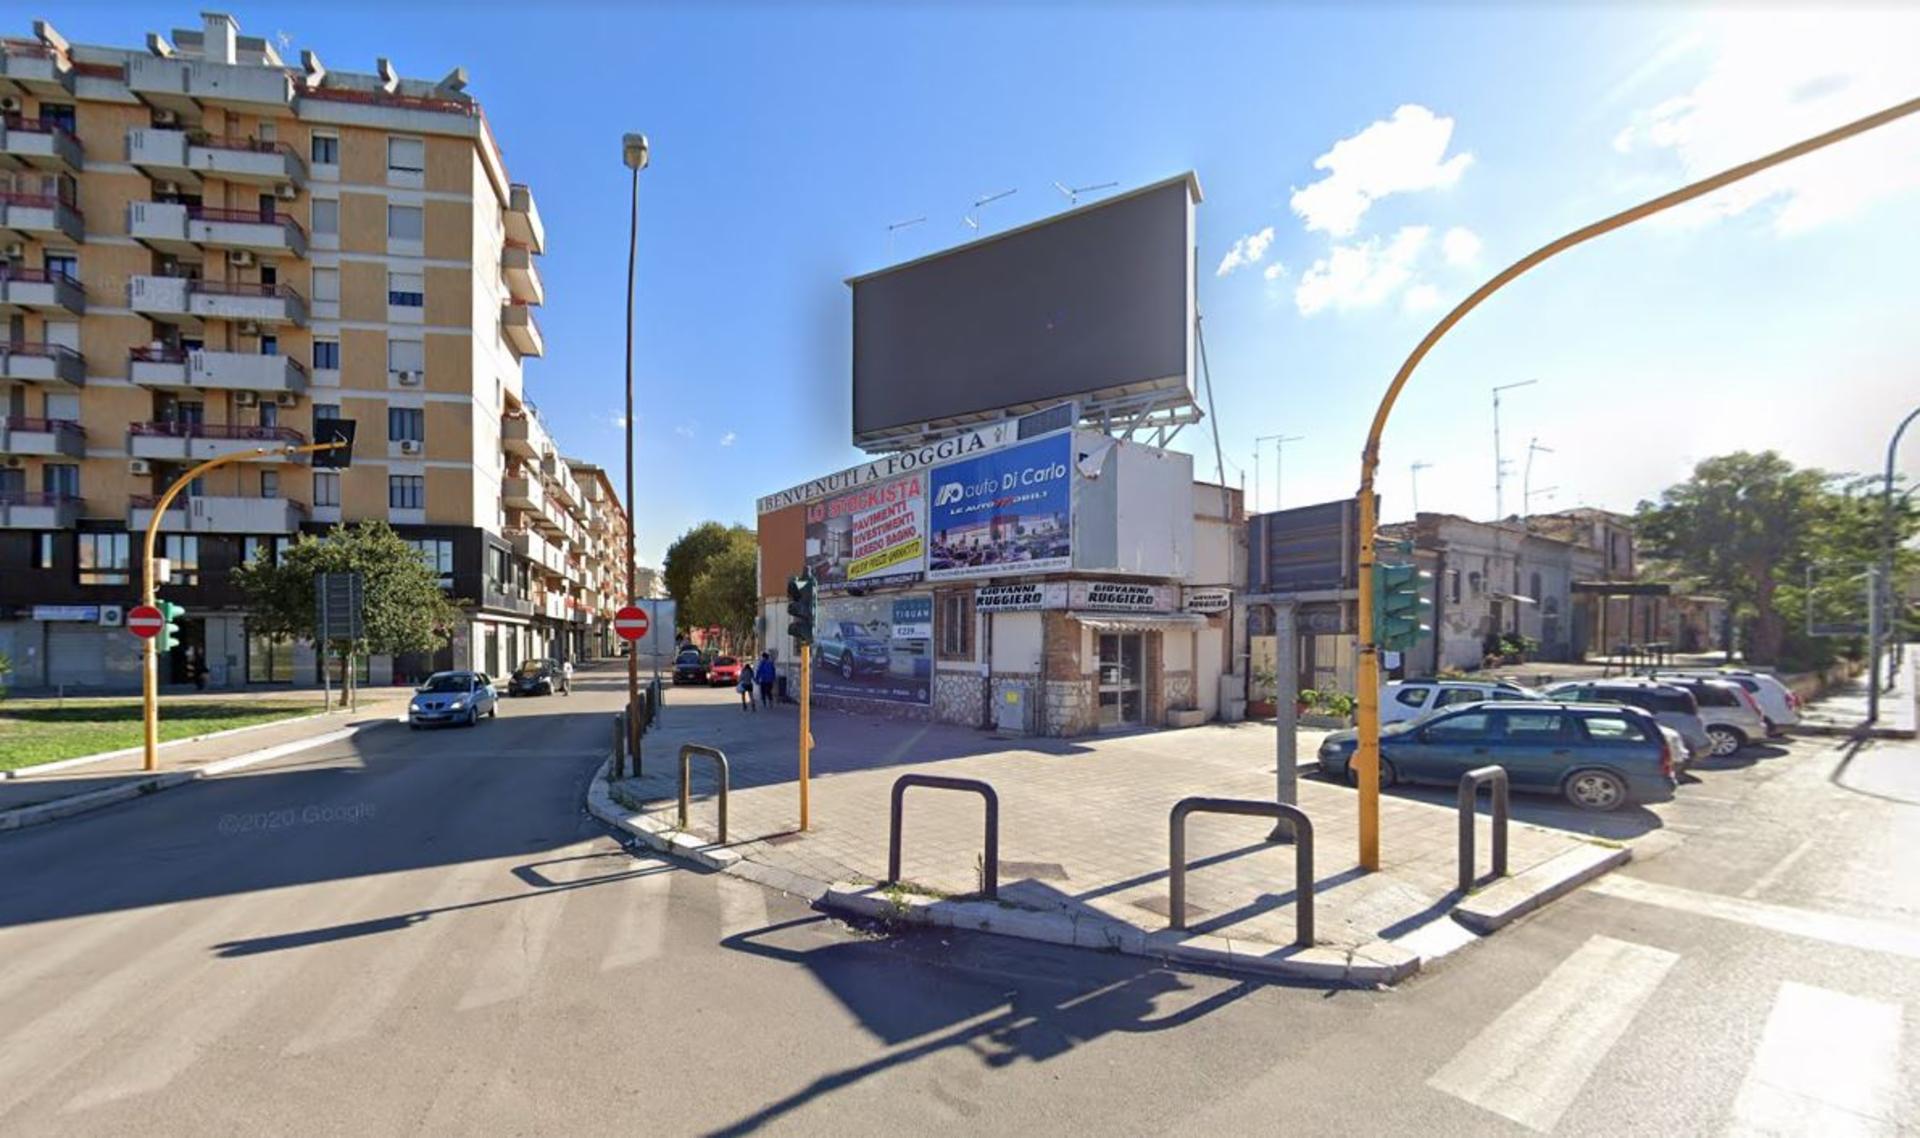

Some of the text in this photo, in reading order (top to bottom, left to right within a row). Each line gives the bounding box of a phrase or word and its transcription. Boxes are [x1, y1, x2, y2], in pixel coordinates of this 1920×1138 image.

[765, 432, 985, 511] BENVENUTI A FOGGIA
[965, 461, 1066, 498] auto Di Carlo
[807, 477, 920, 524] LO STOCKISTA
[853, 500, 907, 533] PAVIMENTI
[853, 511, 915, 547] RIVESTIMENTI
[855, 525, 917, 560] ARREDO BAGNO
[976, 592, 1042, 606] RUGGIERO
[980, 584, 1036, 596] GIOVANNI
[1088, 592, 1154, 605] RUGGIERO
[1094, 584, 1149, 595] GIOVANNI
